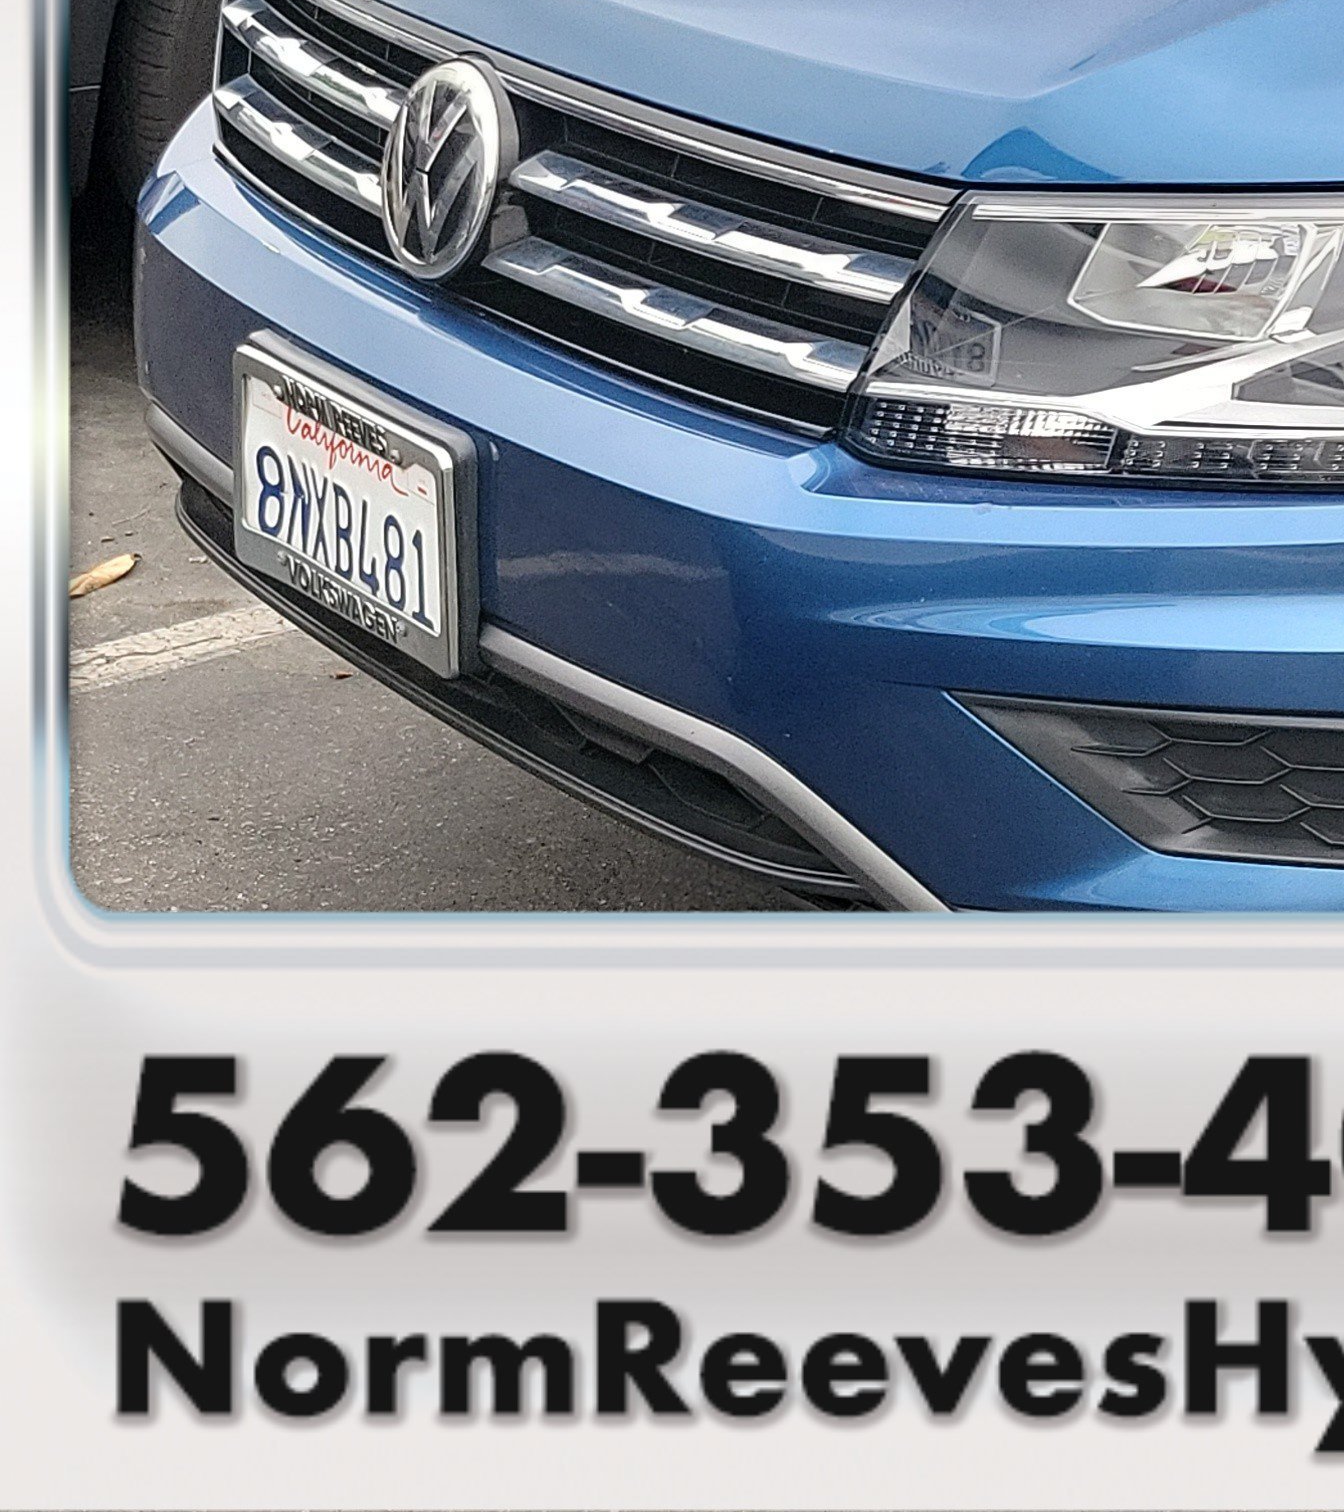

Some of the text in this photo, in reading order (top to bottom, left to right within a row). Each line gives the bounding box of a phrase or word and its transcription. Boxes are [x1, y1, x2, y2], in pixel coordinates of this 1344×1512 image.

[286, 406, 409, 497] California
[256, 445, 435, 631] 8NXB481
[286, 558, 400, 644] VOLKSWAGEN
